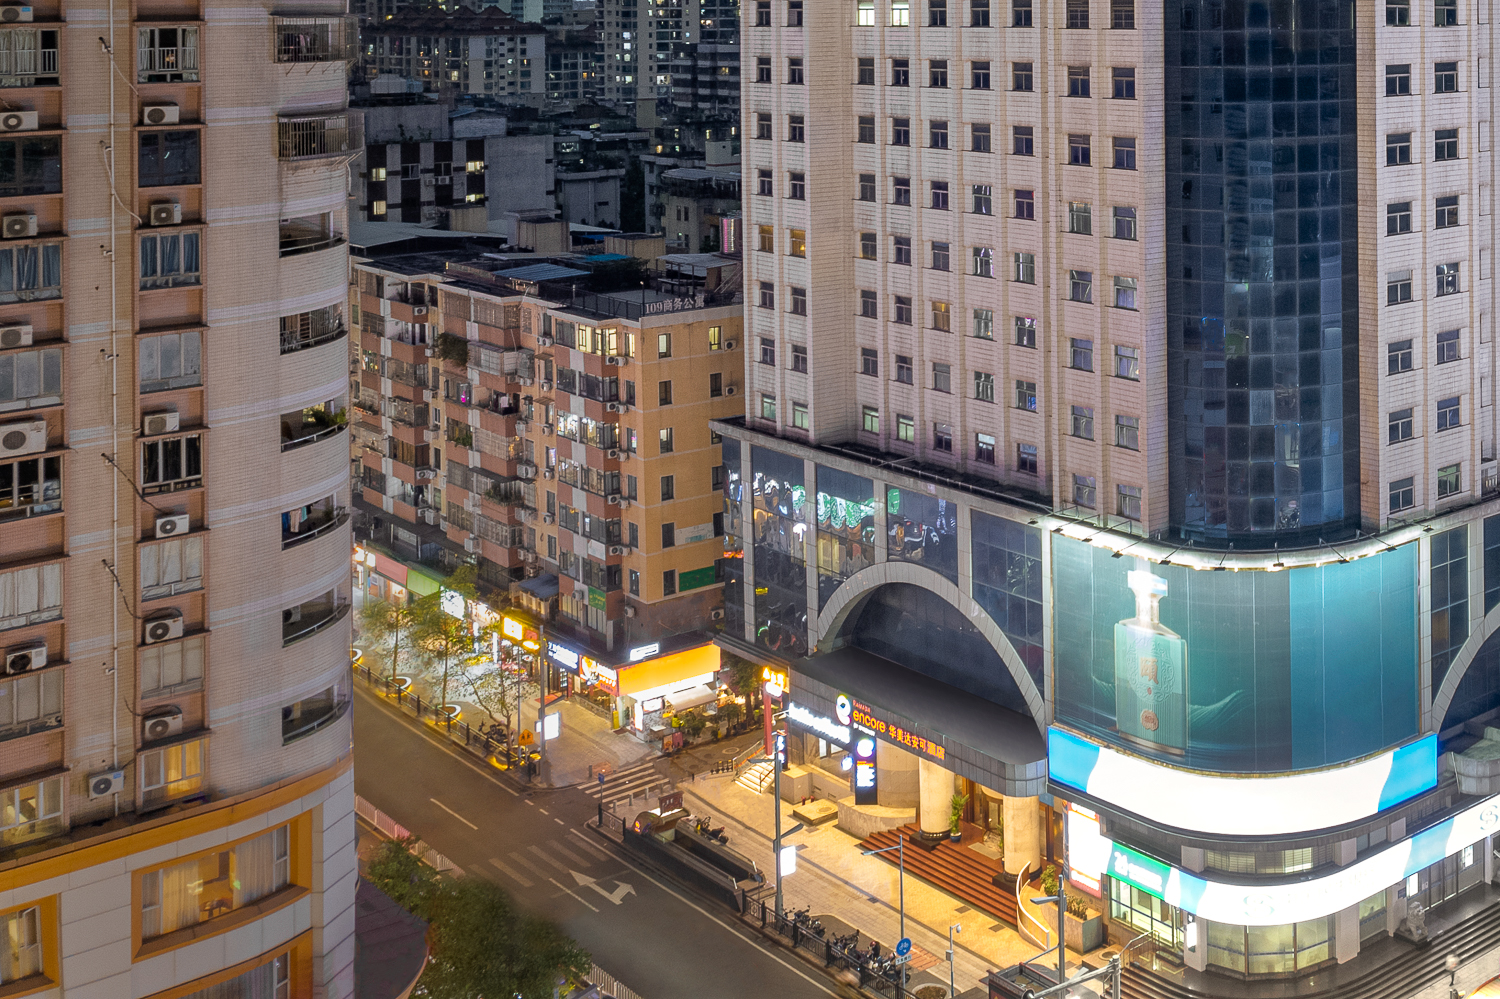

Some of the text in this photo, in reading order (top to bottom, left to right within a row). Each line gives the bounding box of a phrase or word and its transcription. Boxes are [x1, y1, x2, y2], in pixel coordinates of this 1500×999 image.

[646, 293, 705, 314] 109商务公寓
[852, 699, 871, 714] RAMADA
[852, 709, 887, 733] encore
[888, 724, 946, 761] 华美达安可酒店
